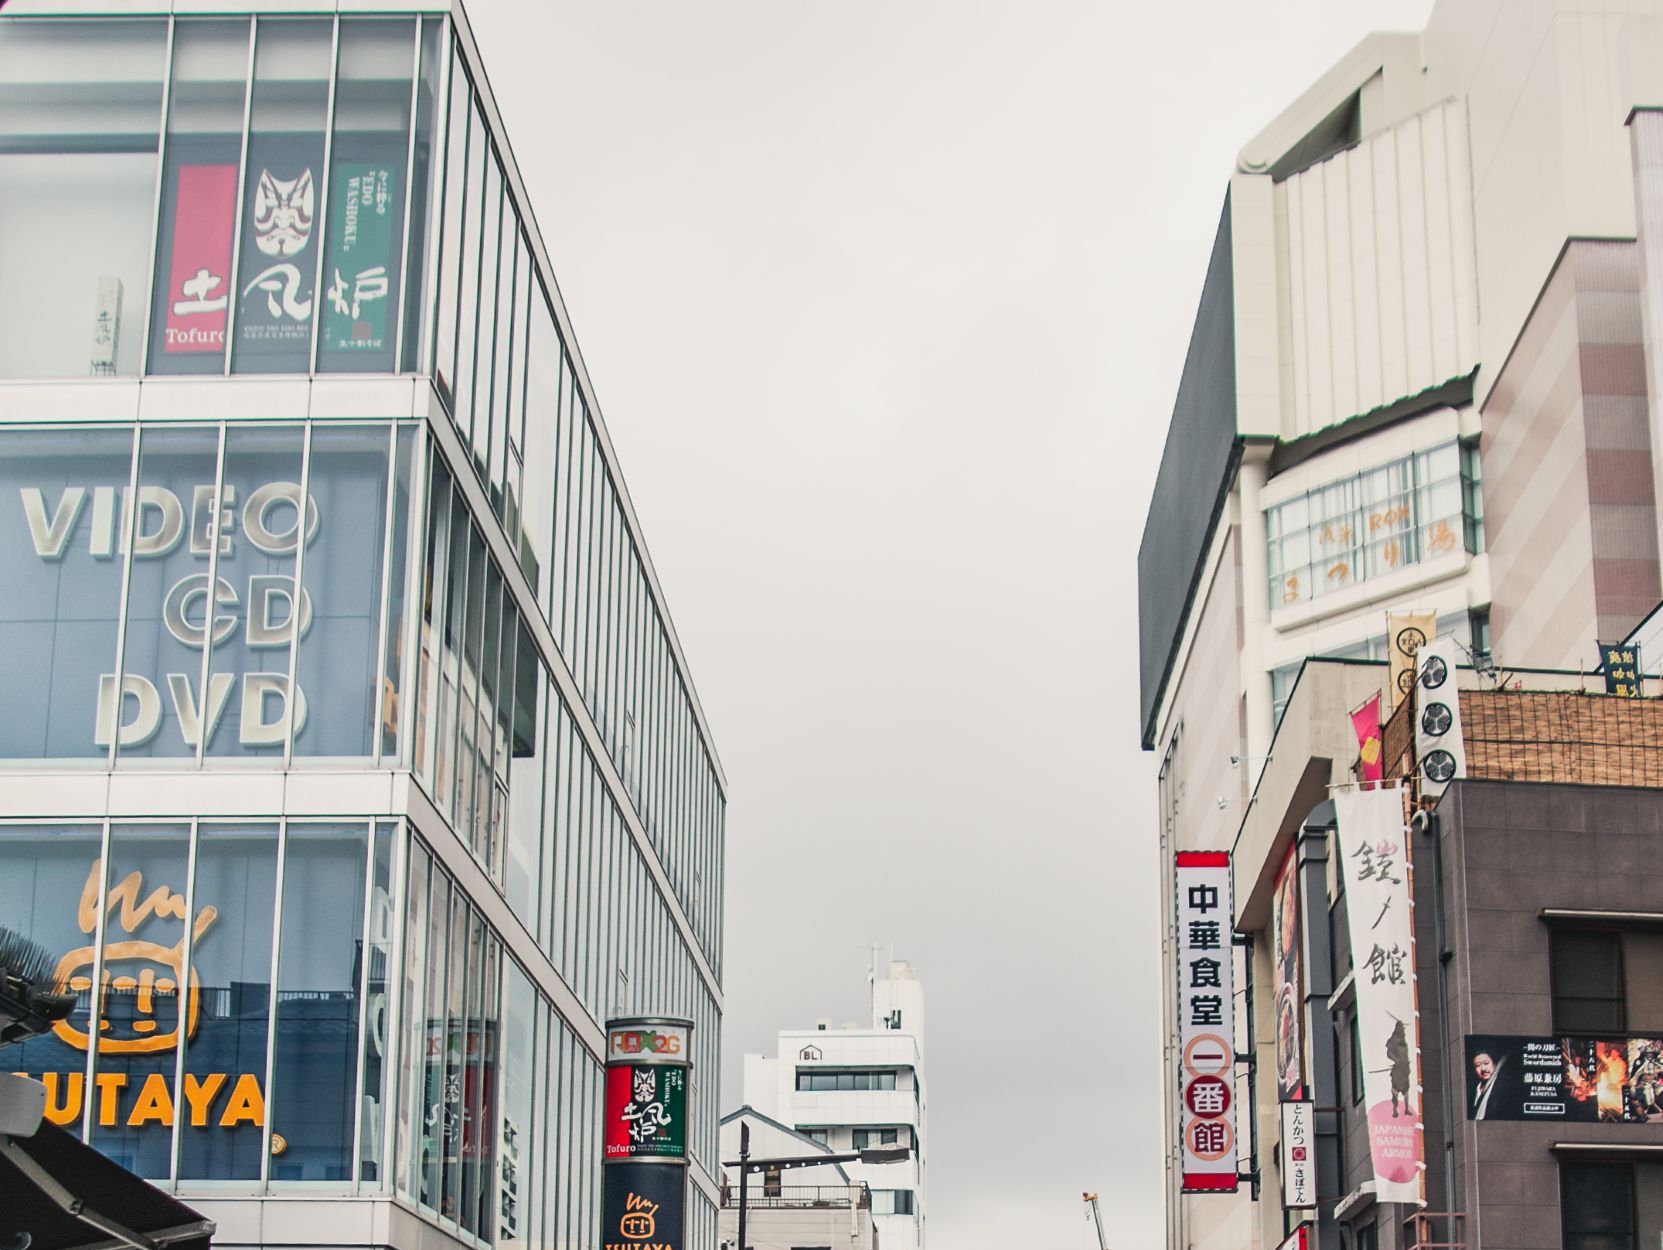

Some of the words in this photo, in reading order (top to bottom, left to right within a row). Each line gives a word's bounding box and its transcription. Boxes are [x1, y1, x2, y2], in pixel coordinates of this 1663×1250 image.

[20, 481, 321, 560] VIDEO
[163, 573, 314, 649] CD
[94, 672, 308, 748] DVD
[803, 1051, 818, 1060] BL
[10, 1072, 264, 1127] UTAYA
[1293, 1104, 1304, 1145] とんかつ
[606, 1144, 636, 1155] Tofuro
